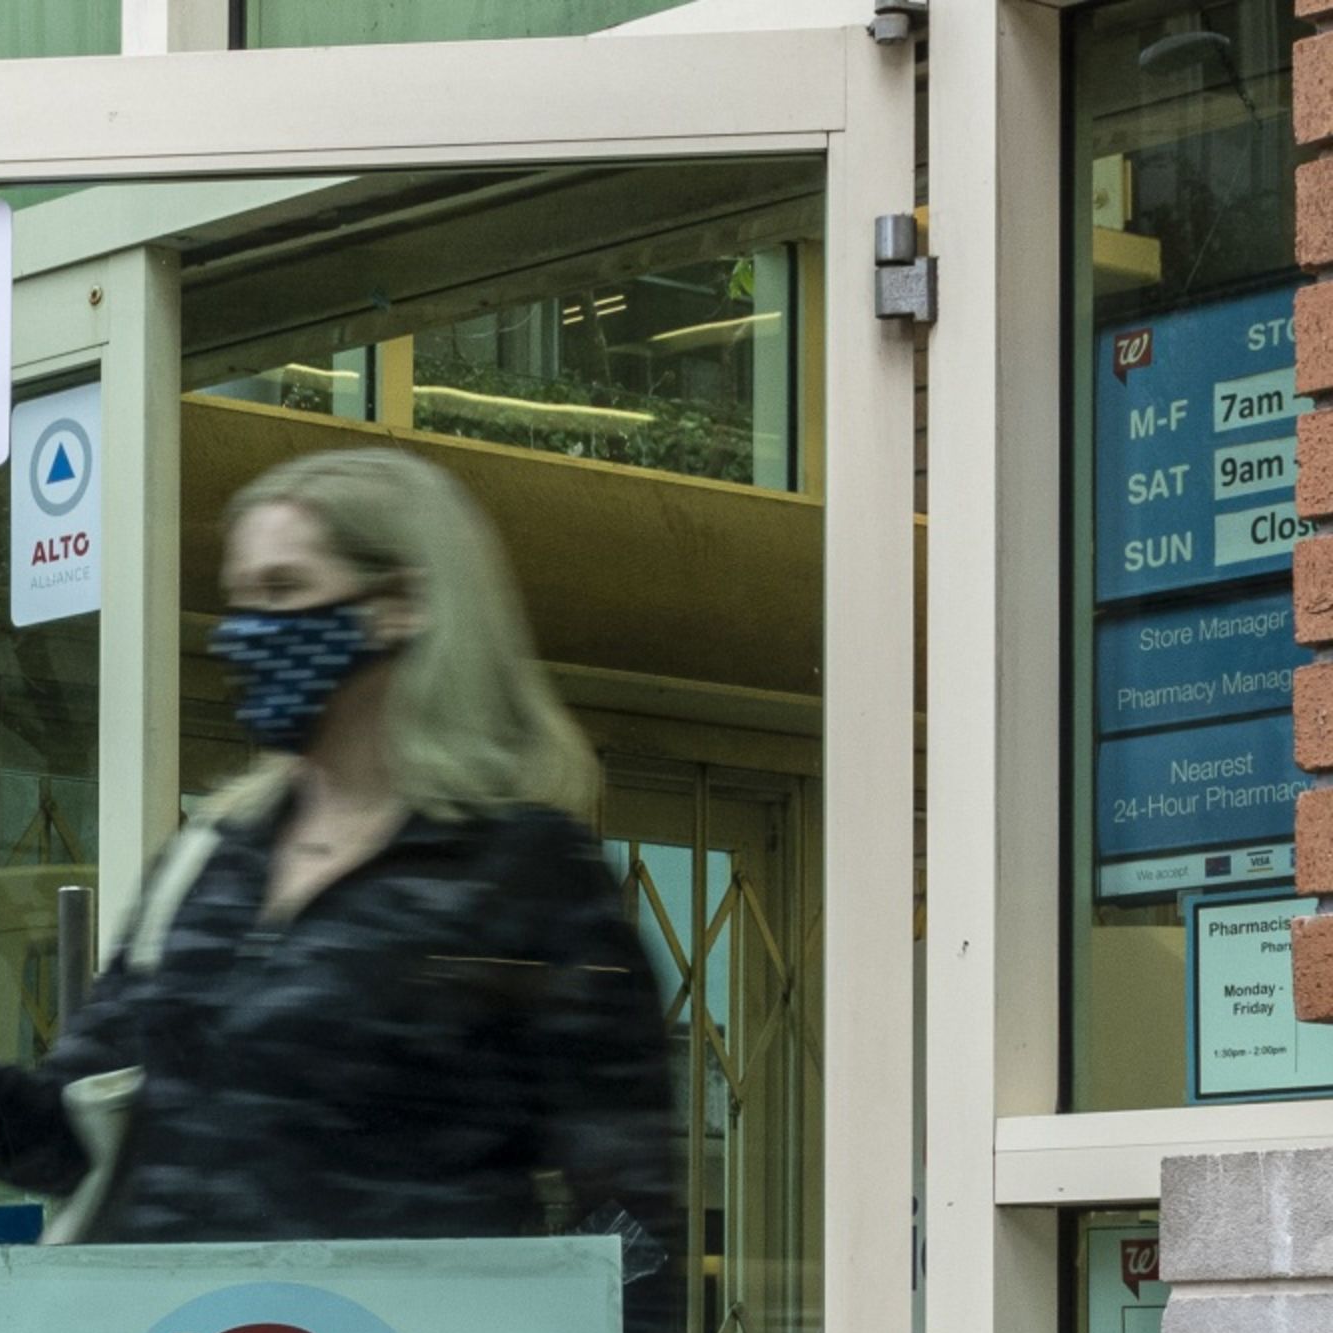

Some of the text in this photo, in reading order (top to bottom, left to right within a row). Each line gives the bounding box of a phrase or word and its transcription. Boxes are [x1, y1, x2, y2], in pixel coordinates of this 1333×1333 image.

[1130, 390, 1283, 440] M-F 7am
[1127, 454, 1284, 505] SAT 9am
[31, 532, 90, 566] ALTO
[1124, 531, 1193, 571] SUN
[31, 566, 90, 589] ALLIANCE
[1139, 610, 1289, 651] Store Manager
[1118, 680, 1216, 711] Pharmacy
[1170, 752, 1254, 784] Nearest
[1113, 793, 1200, 824] 24-Hour
[1250, 856, 1271, 867] VISA
[1208, 915, 1295, 937] Pharmacis
[1224, 982, 1275, 998] Monday
[1233, 1001, 1274, 1016] Friday
